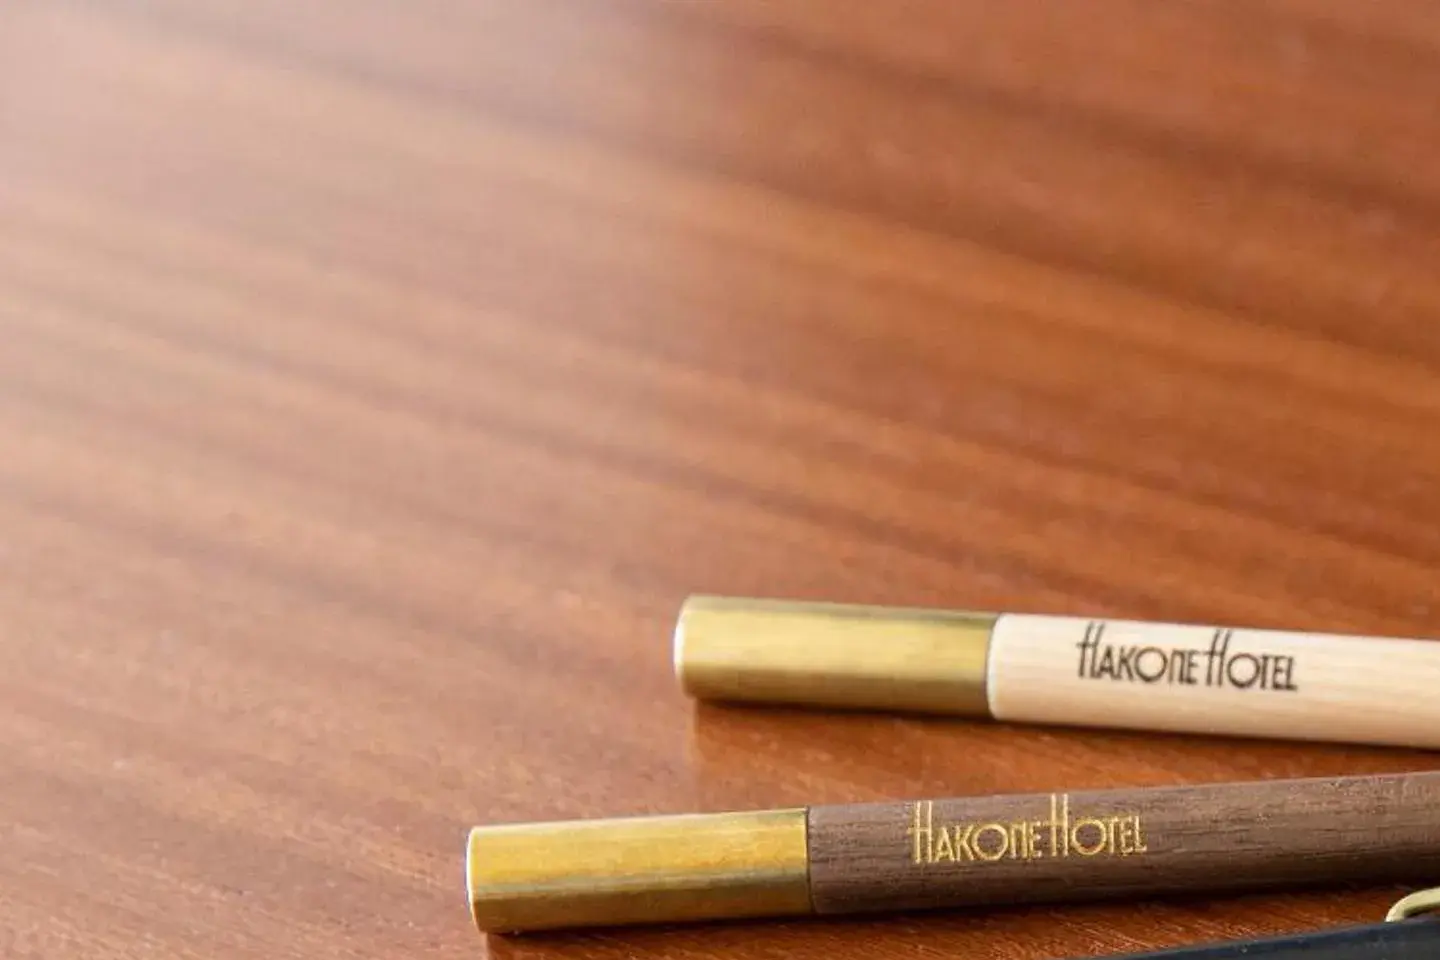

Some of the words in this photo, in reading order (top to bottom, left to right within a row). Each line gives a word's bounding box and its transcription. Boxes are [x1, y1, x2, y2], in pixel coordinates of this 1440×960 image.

[1076, 621, 1198, 684] HAKONE
[1202, 628, 1298, 691] HOTEL
[907, 800, 1042, 864] HAKONE
[1042, 793, 1147, 857] HOTEL
